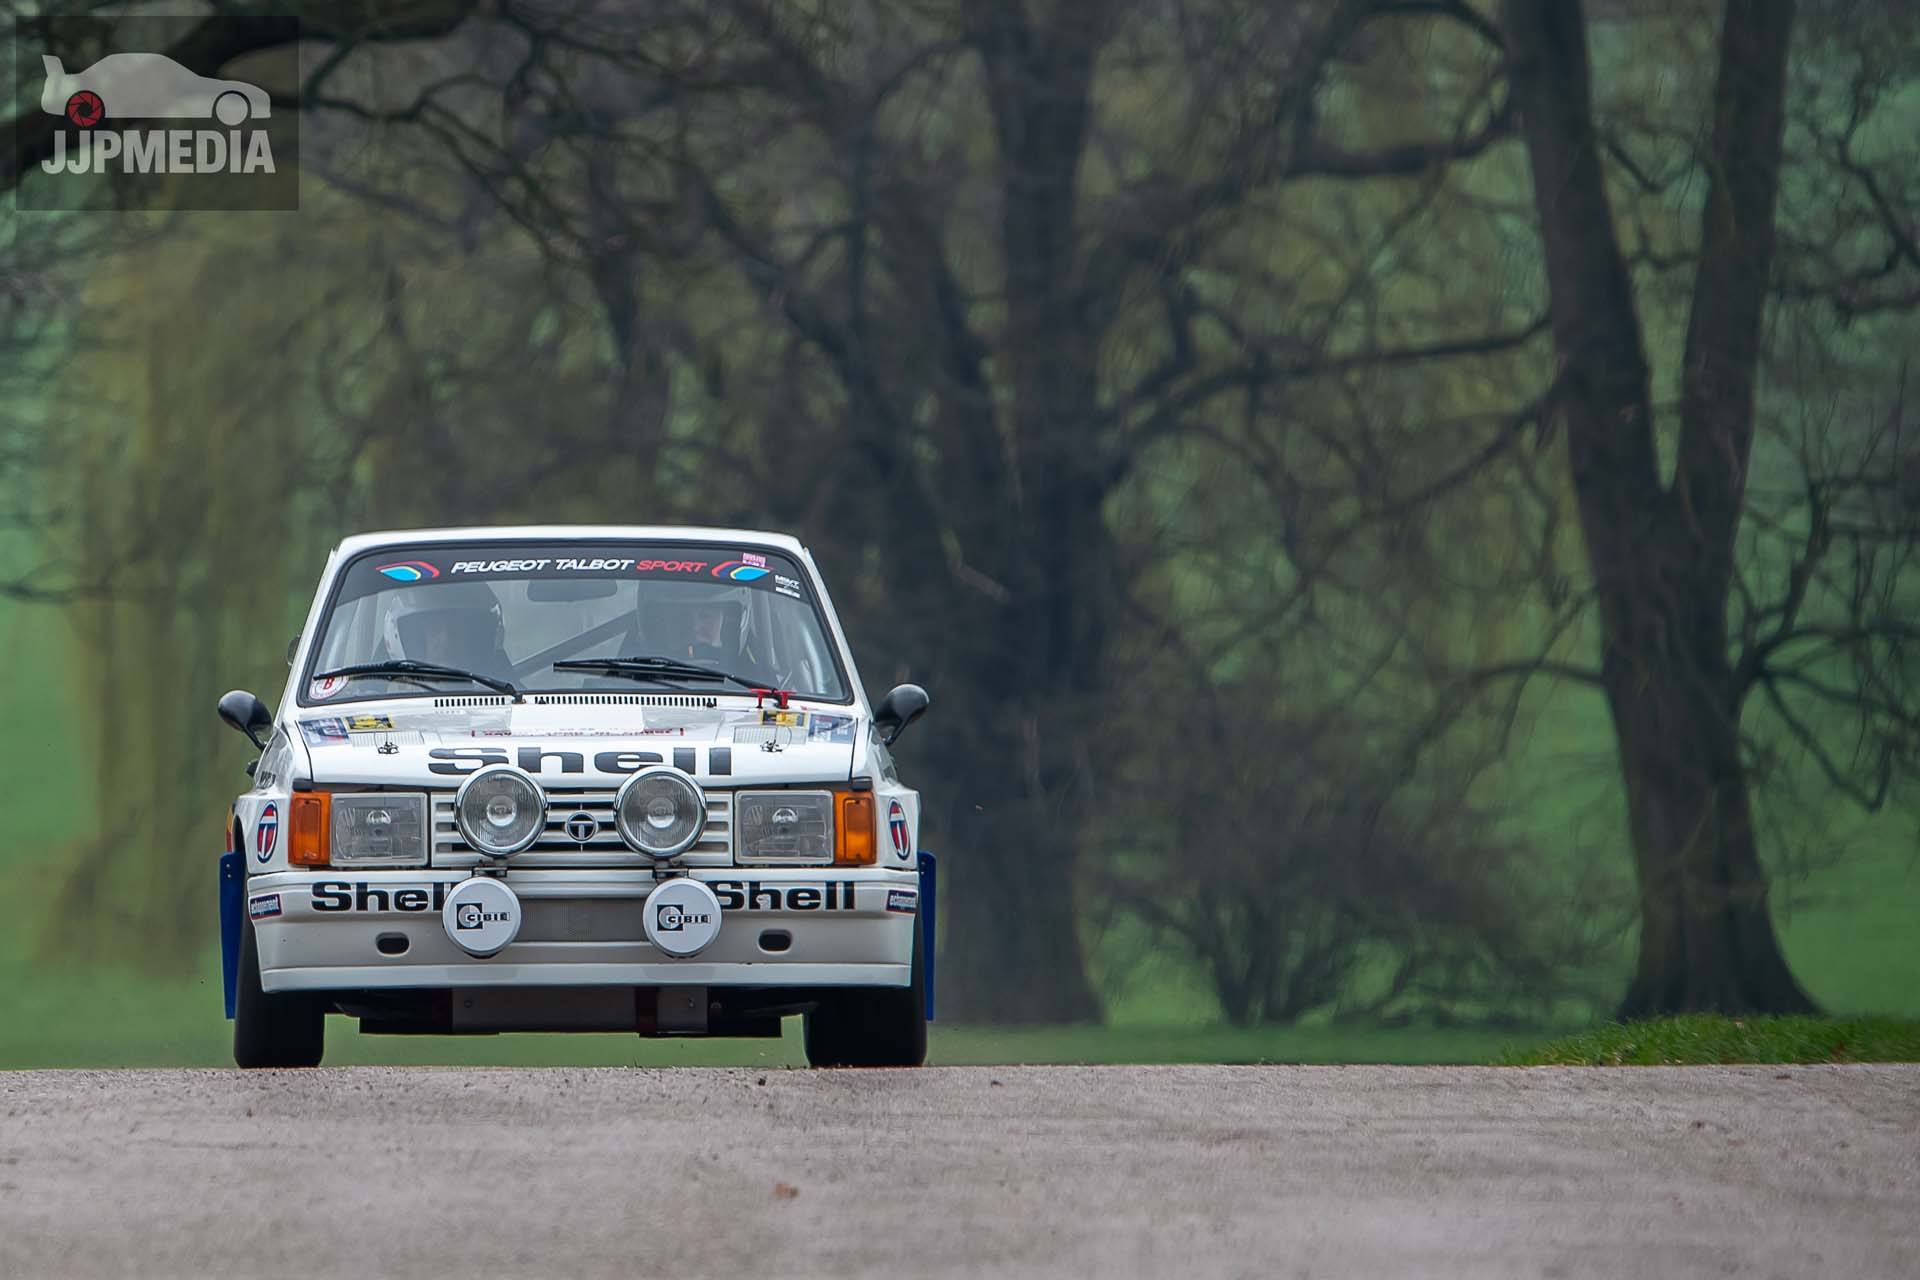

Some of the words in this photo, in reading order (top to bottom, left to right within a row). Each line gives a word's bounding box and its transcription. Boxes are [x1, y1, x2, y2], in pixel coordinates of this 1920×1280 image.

[451, 560, 550, 574] PEUGEOT
[556, 559, 634, 572] TALBOT
[636, 560, 707, 573] SPORT
[428, 747, 732, 775] Shell
[703, 880, 855, 910] Shell
